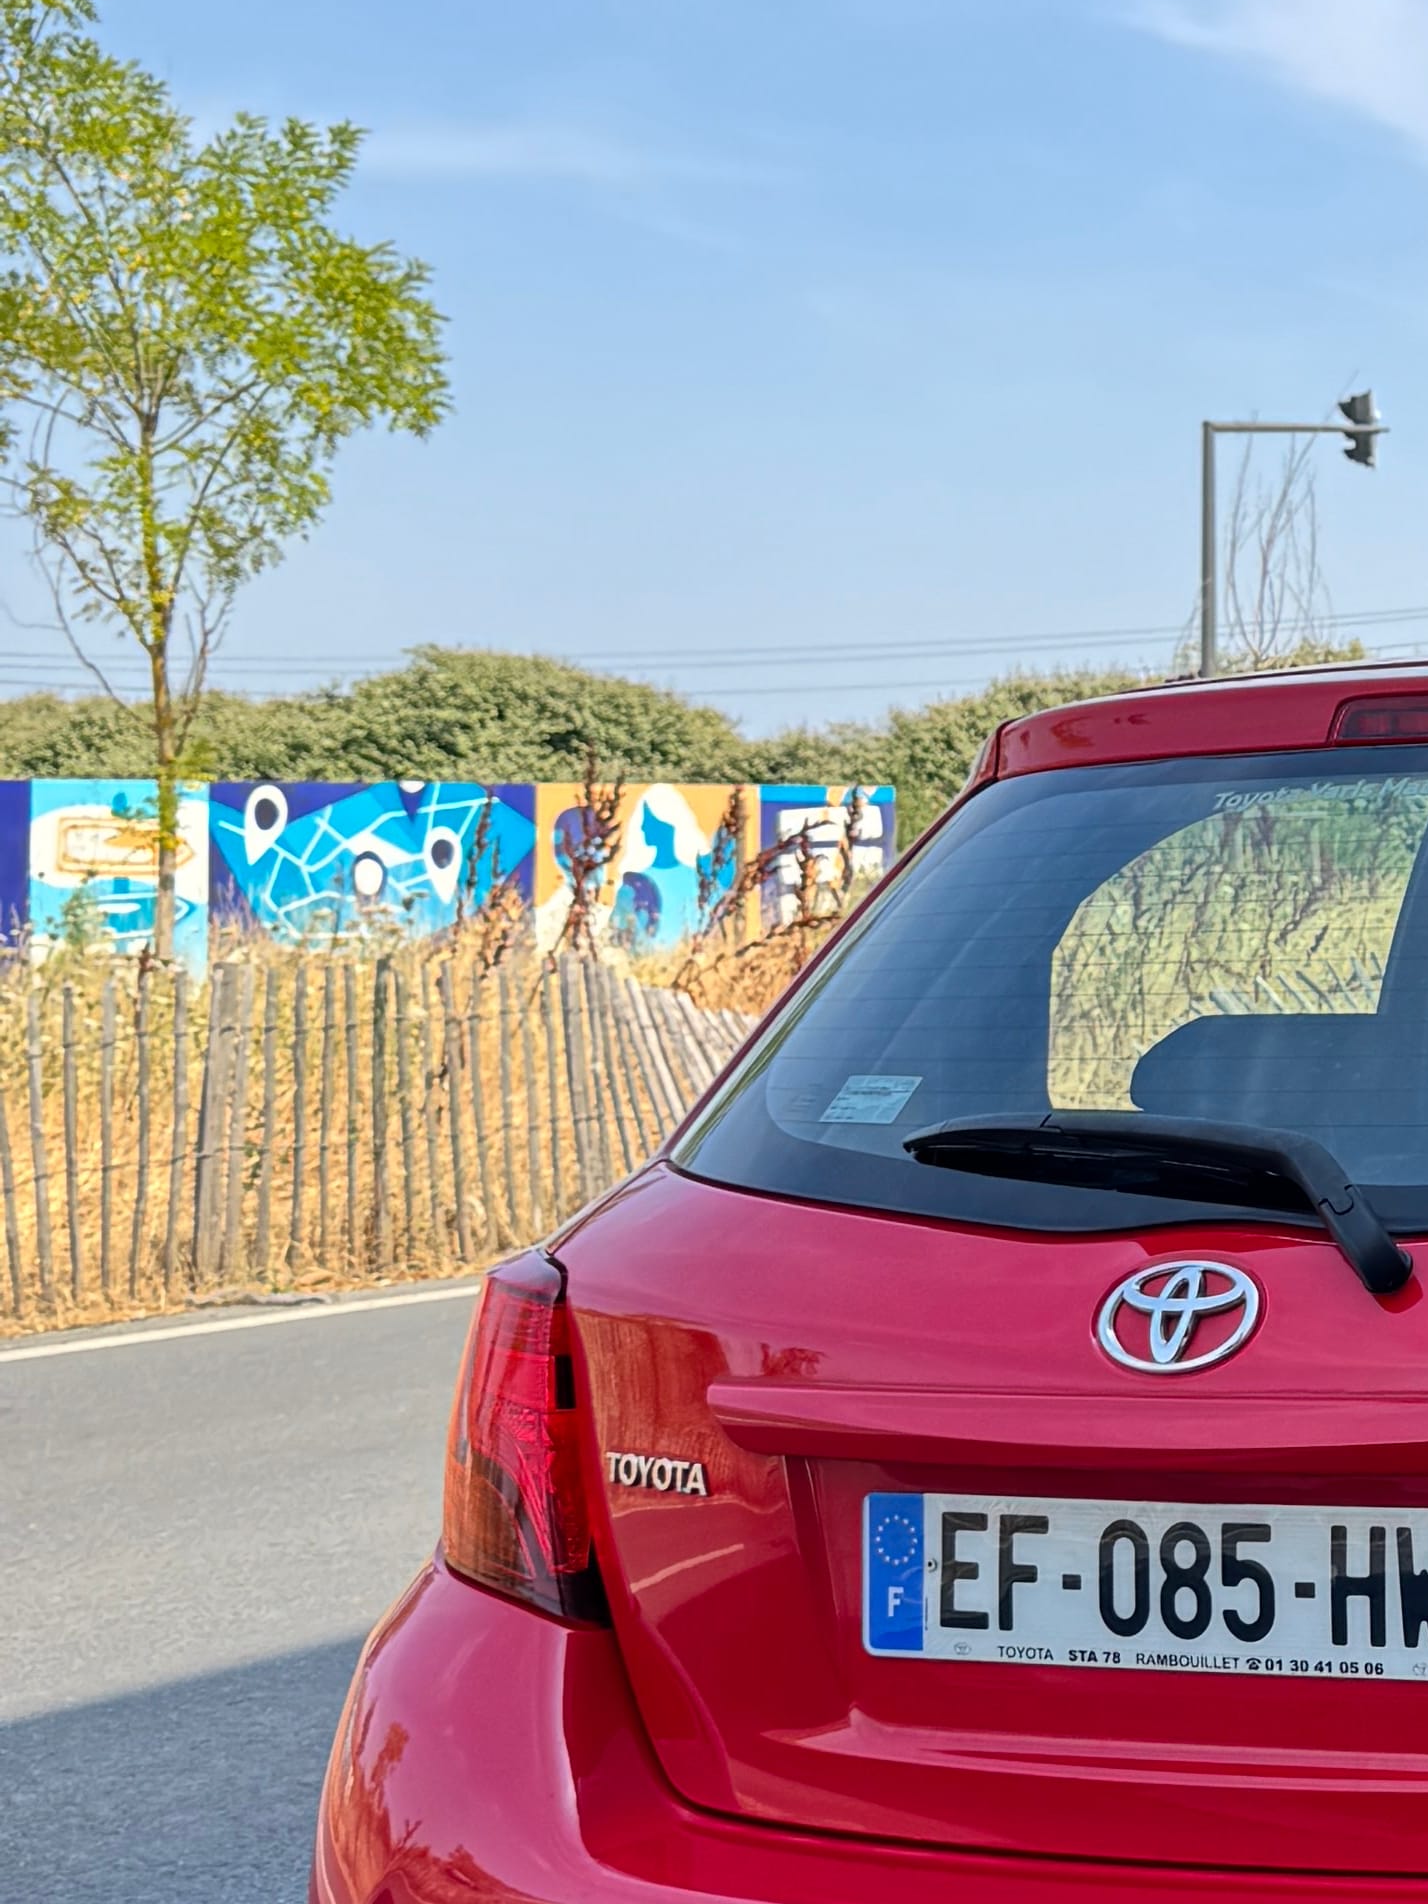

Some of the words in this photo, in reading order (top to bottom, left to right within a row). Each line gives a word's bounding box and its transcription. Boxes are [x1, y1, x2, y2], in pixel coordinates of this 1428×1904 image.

[1213, 786, 1302, 812] Toyota
[1311, 779, 1374, 800] Yaris
[606, 1451, 708, 1496] TOYOTA
[888, 1586, 904, 1617] F
[998, 1646, 1054, 1661] TOYOTA
[1068, 1650, 1098, 1663] STA
[1103, 1651, 1121, 1664] 78
[1136, 1653, 1241, 1670] RAMBOUILLET
[1265, 1658, 1283, 1671] 01
[1290, 1659, 1309, 1672] 30
[1314, 1660, 1333, 1673] 41
[1339, 1661, 1359, 1673] 05
[1364, 1662, 1384, 1675] 06
